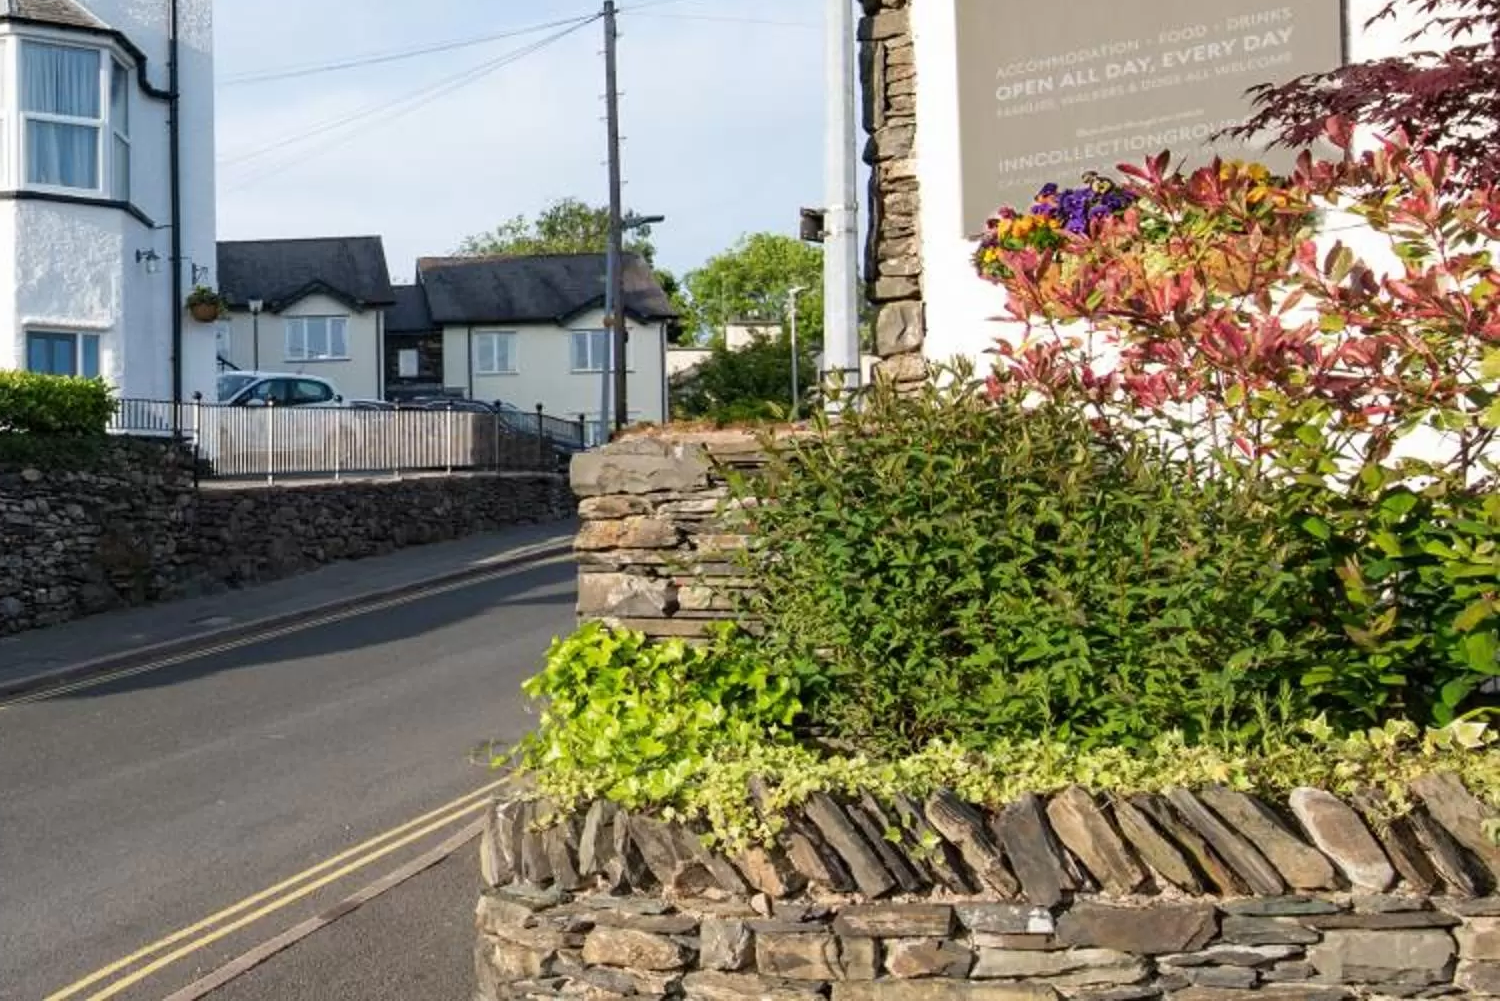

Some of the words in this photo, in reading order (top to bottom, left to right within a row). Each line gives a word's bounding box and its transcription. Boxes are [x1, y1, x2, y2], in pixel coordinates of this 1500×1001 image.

[996, 38, 1140, 79] ACCOMMODATION
[1159, 24, 1207, 44] FOOD
[1226, 7, 1294, 31] DRINKS
[996, 75, 1054, 101] OPEN
[1059, 67, 1101, 88] ALL
[1105, 56, 1157, 80] DAY,
[1162, 38, 1237, 68] EVERY
[1243, 25, 1295, 52] DAY
[1214, 51, 1293, 77] WELCOME
